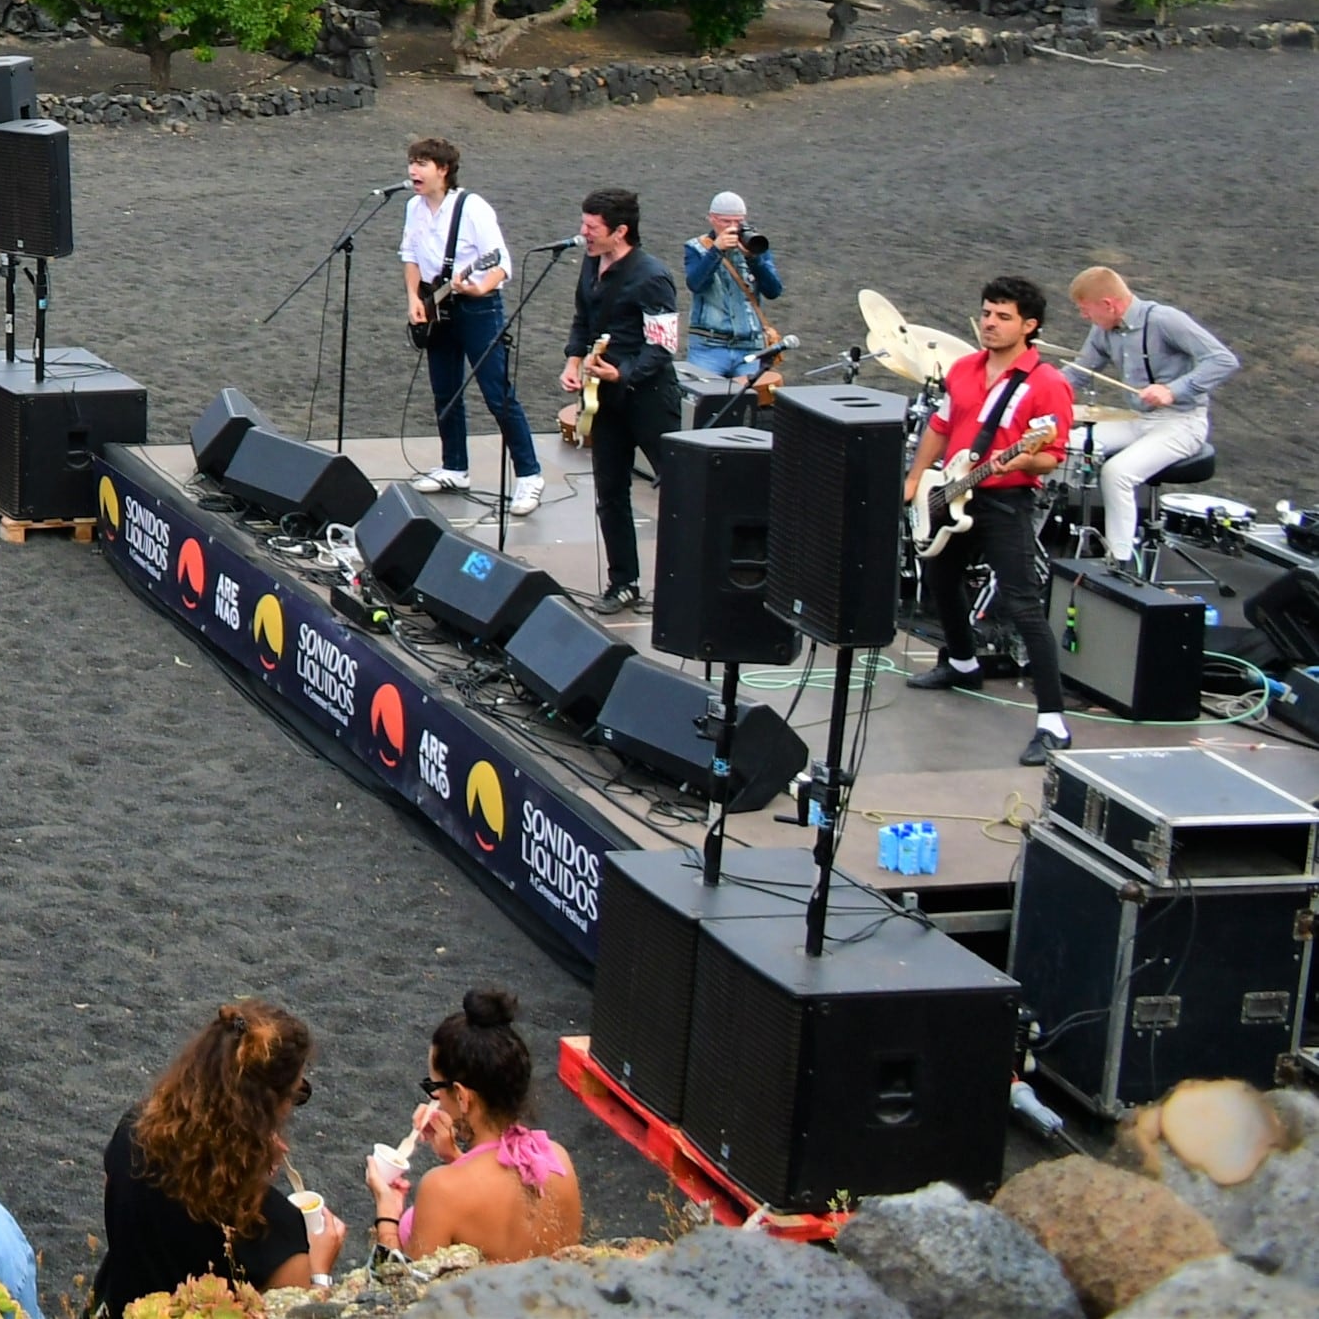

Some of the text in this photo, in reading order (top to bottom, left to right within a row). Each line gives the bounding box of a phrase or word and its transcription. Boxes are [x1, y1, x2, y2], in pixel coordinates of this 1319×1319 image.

[125, 495, 170, 548] SONIDOS
[216, 573, 240, 606] ARE
[298, 623, 358, 688] SONIDOS
[419, 729, 449, 772] ARE
[522, 800, 600, 888] SONIDOS
